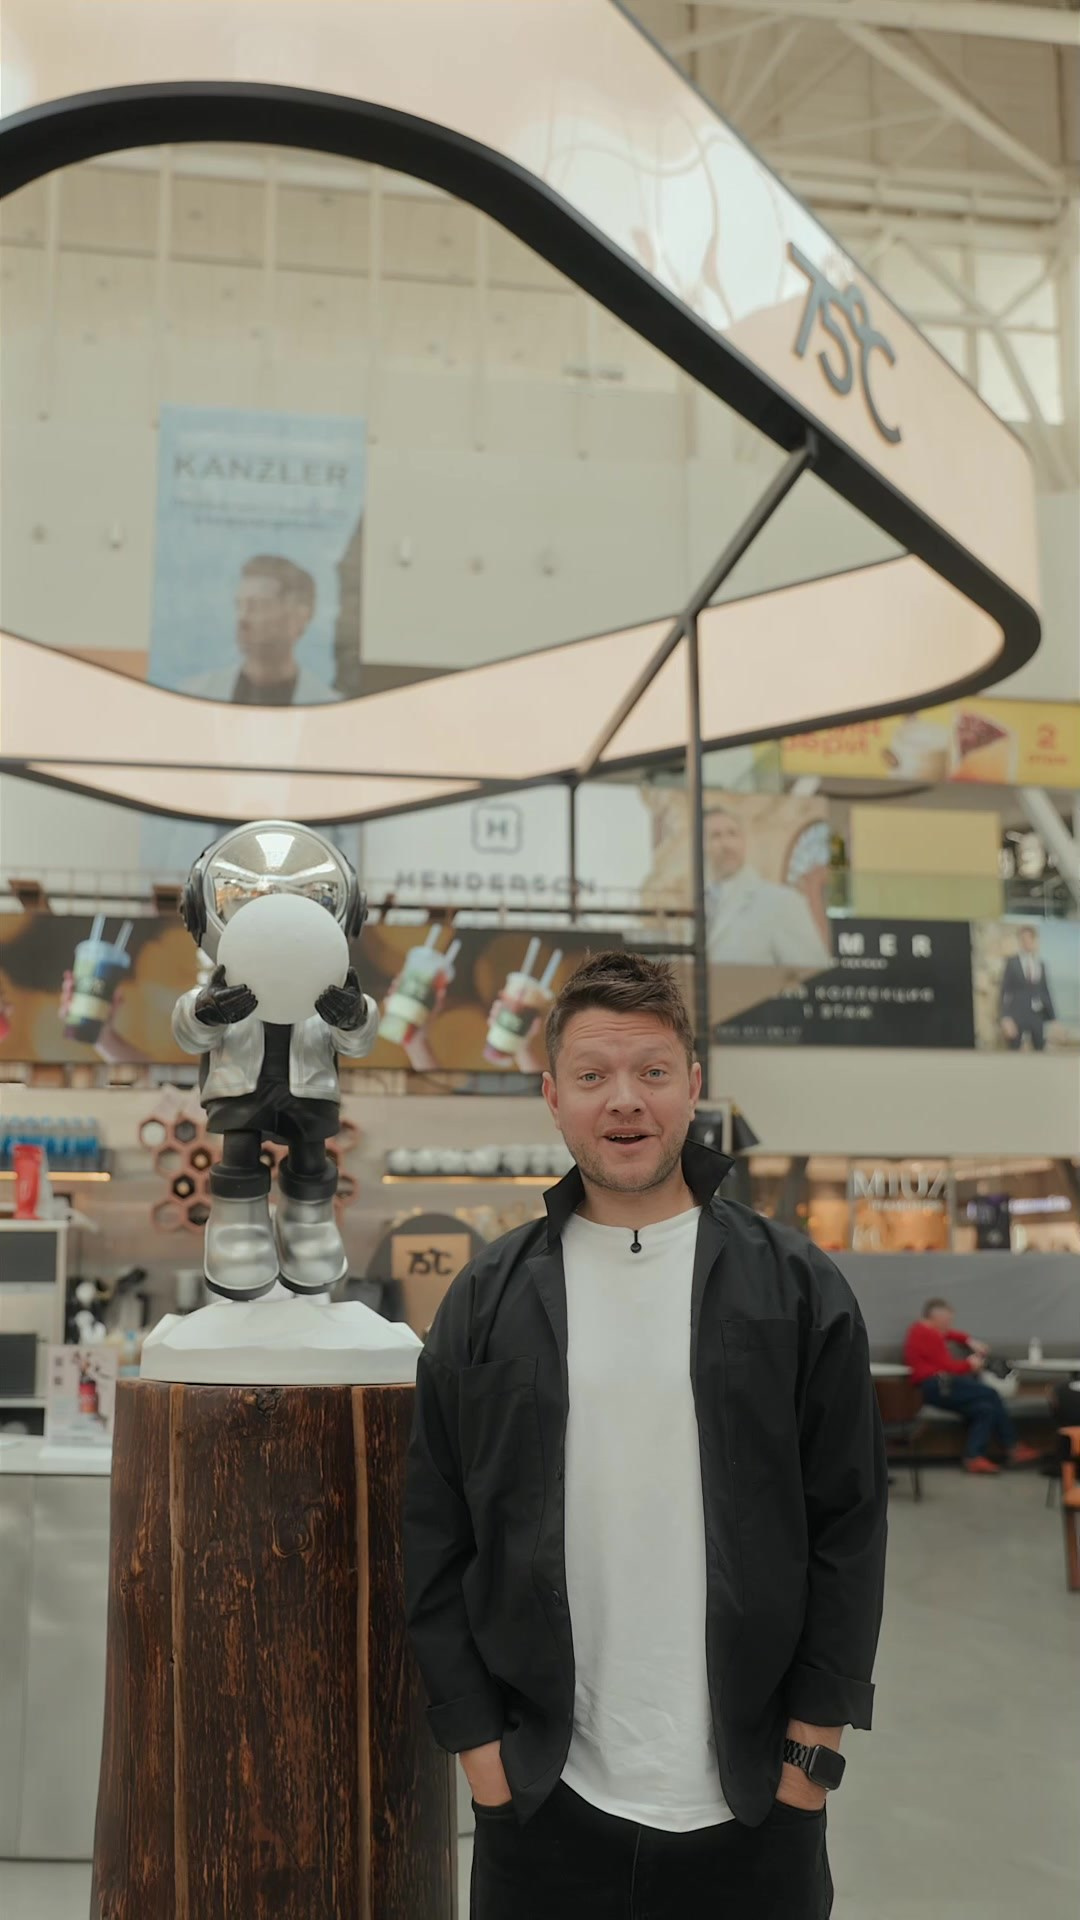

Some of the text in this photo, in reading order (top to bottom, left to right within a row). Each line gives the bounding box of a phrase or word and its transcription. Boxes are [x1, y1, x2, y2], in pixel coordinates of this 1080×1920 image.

[173, 455, 348, 487] KANZLER
[396, 871, 595, 893] HENDERSON
[815, 984, 935, 1003] КОЛЛЕКЦИЯ
